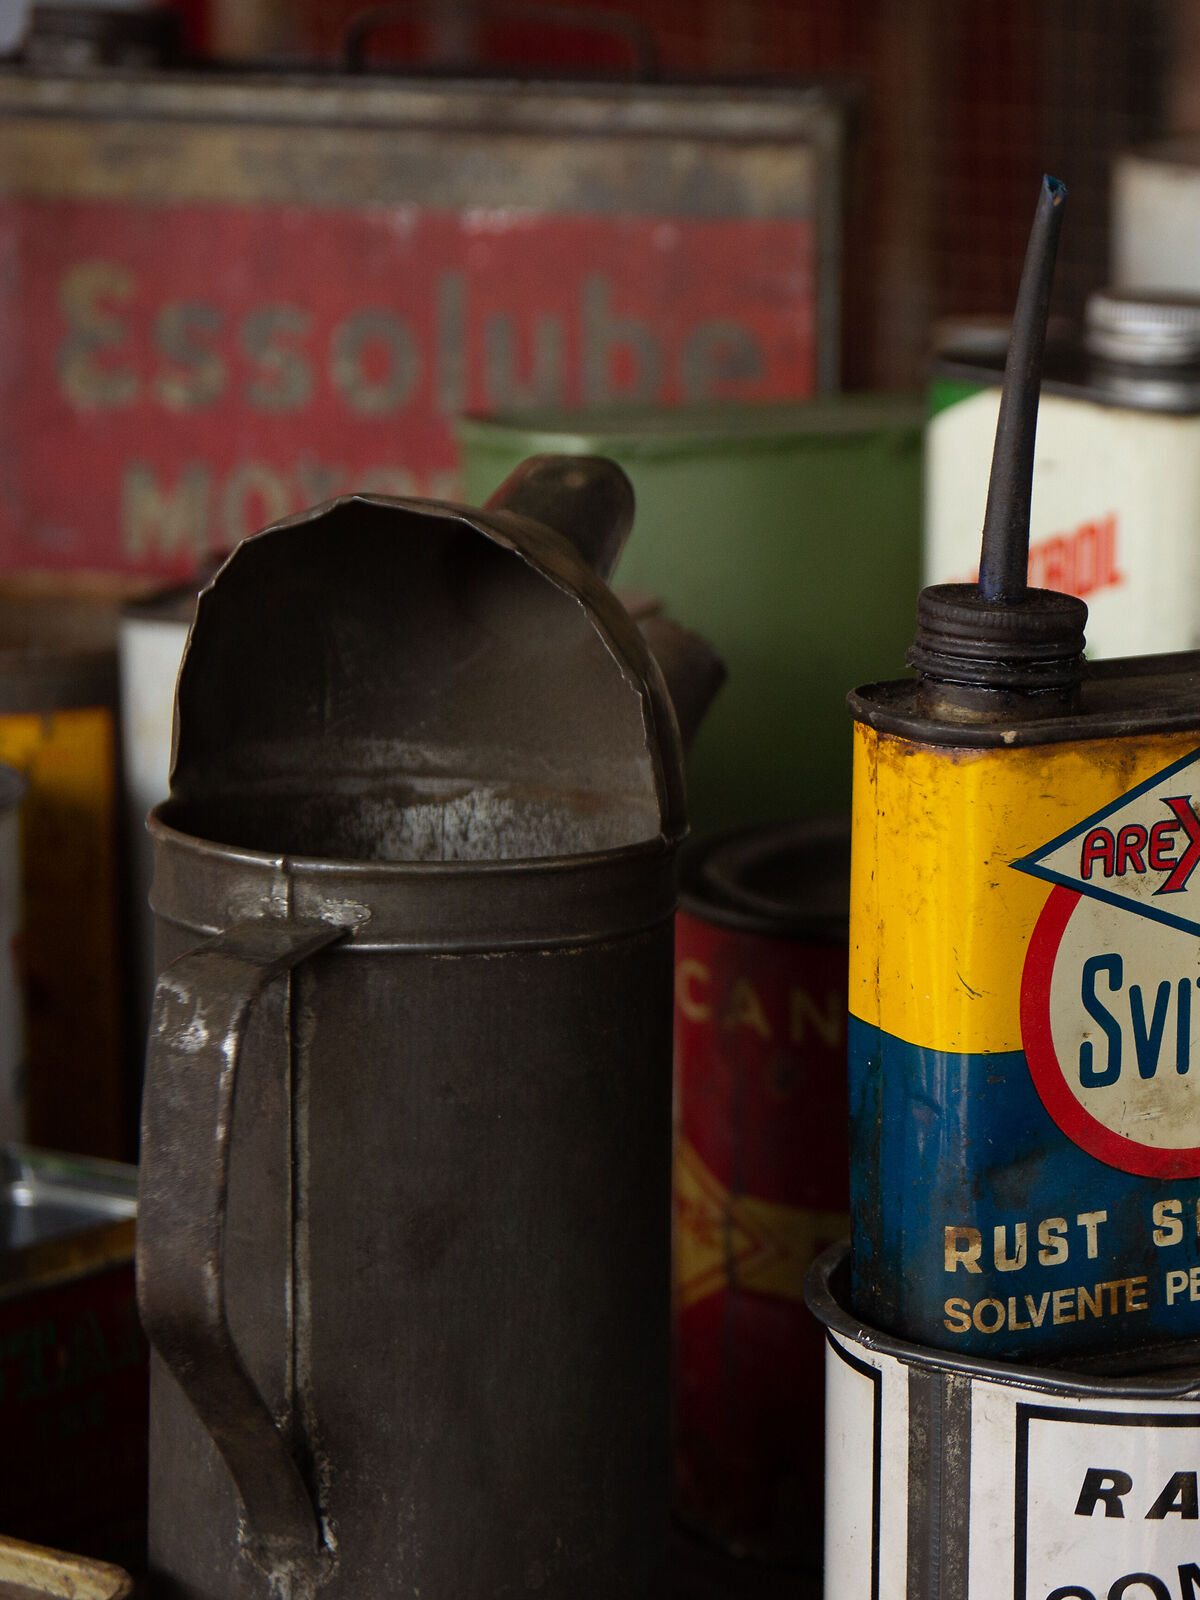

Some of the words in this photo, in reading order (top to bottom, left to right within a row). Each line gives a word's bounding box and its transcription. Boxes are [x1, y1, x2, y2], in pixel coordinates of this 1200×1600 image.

[57, 258, 766, 418] Essolube
[943, 1210, 1108, 1274] RUST
[943, 1275, 1148, 1334] SOLVENTE
